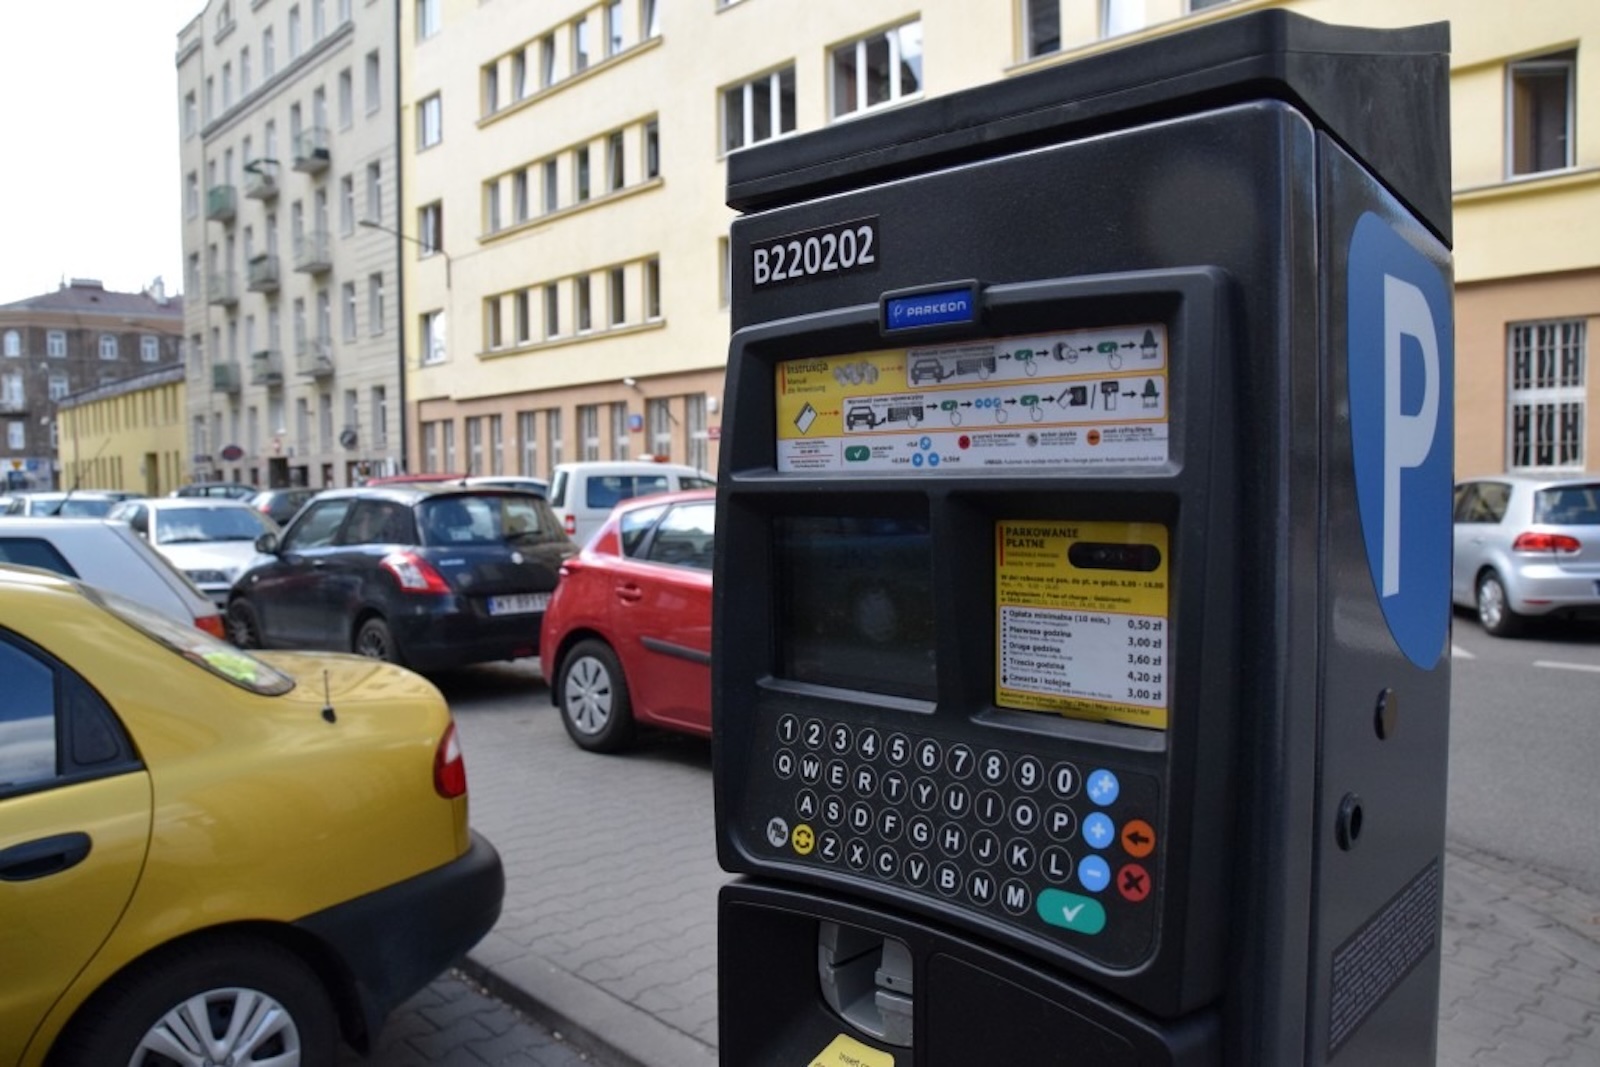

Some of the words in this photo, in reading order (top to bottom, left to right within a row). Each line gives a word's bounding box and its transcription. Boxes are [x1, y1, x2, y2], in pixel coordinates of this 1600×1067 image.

[753, 225, 875, 285] B220202
[906, 299, 967, 317] PARKEON
[1383, 273, 1440, 598] P
[1005, 526, 1079, 539] PARKOWANIE
[1005, 538, 1046, 549] PŁATNE
[1034, 611, 1073, 622] minimalna
[1127, 619, 1150, 631] 0,50
[1152, 621, 1162, 631] zł
[1009, 625, 1041, 636] Pierwsza
[1043, 627, 1072, 638] godzina
[1127, 637, 1150, 648] 3,00
[1152, 638, 1162, 649] zł
[1009, 641, 1031, 652] Druga
[1032, 643, 1061, 654] godzina
[1127, 654, 1150, 666] 3,60
[1152, 655, 1162, 666] zł
[1009, 657, 1035, 667] Trzecia
[1036, 660, 1065, 671] godzina
[1127, 671, 1150, 683] 4,20
[1152, 672, 1162, 683] zł
[1009, 673, 1038, 684] Czwarta
[1127, 688, 1150, 700] 3,00
[1152, 690, 1162, 700] zł
[785, 720, 792, 739] 1
[808, 724, 819, 744] 2
[835, 729, 846, 749] 3
[862, 735, 874, 755] 4
[892, 739, 904, 760] 5
[923, 745, 935, 766] 6
[955, 750, 967, 772] 7
[987, 756, 1000, 779] 8
[1021, 762, 1035, 785] 9
[779, 755, 791, 774] Q
[803, 760, 819, 778] W
[832, 766, 843, 784] E
[859, 772, 871, 791] R
[889, 778, 900, 796] T
[919, 784, 931, 803] Y
[950, 791, 963, 810] U
[987, 798, 992, 817] I
[1016, 805, 1032, 825] O
[1054, 812, 1068, 831] P
[801, 796, 812, 813] A
[828, 802, 838, 820] S
[855, 808, 867, 826] D
[885, 815, 896, 832] F
[914, 823, 927, 841] G
[945, 830, 959, 850] H
[979, 839, 991, 857] J
[1013, 846, 1028, 866] K
[1050, 854, 1062, 875] L
[824, 838, 835, 856] Z
[851, 845, 863, 863] X
[880, 853, 892, 871] C
[911, 860, 923, 879] V
[941, 869, 954, 888] B
[974, 878, 988, 898] N
[1007, 885, 1024, 907] M
